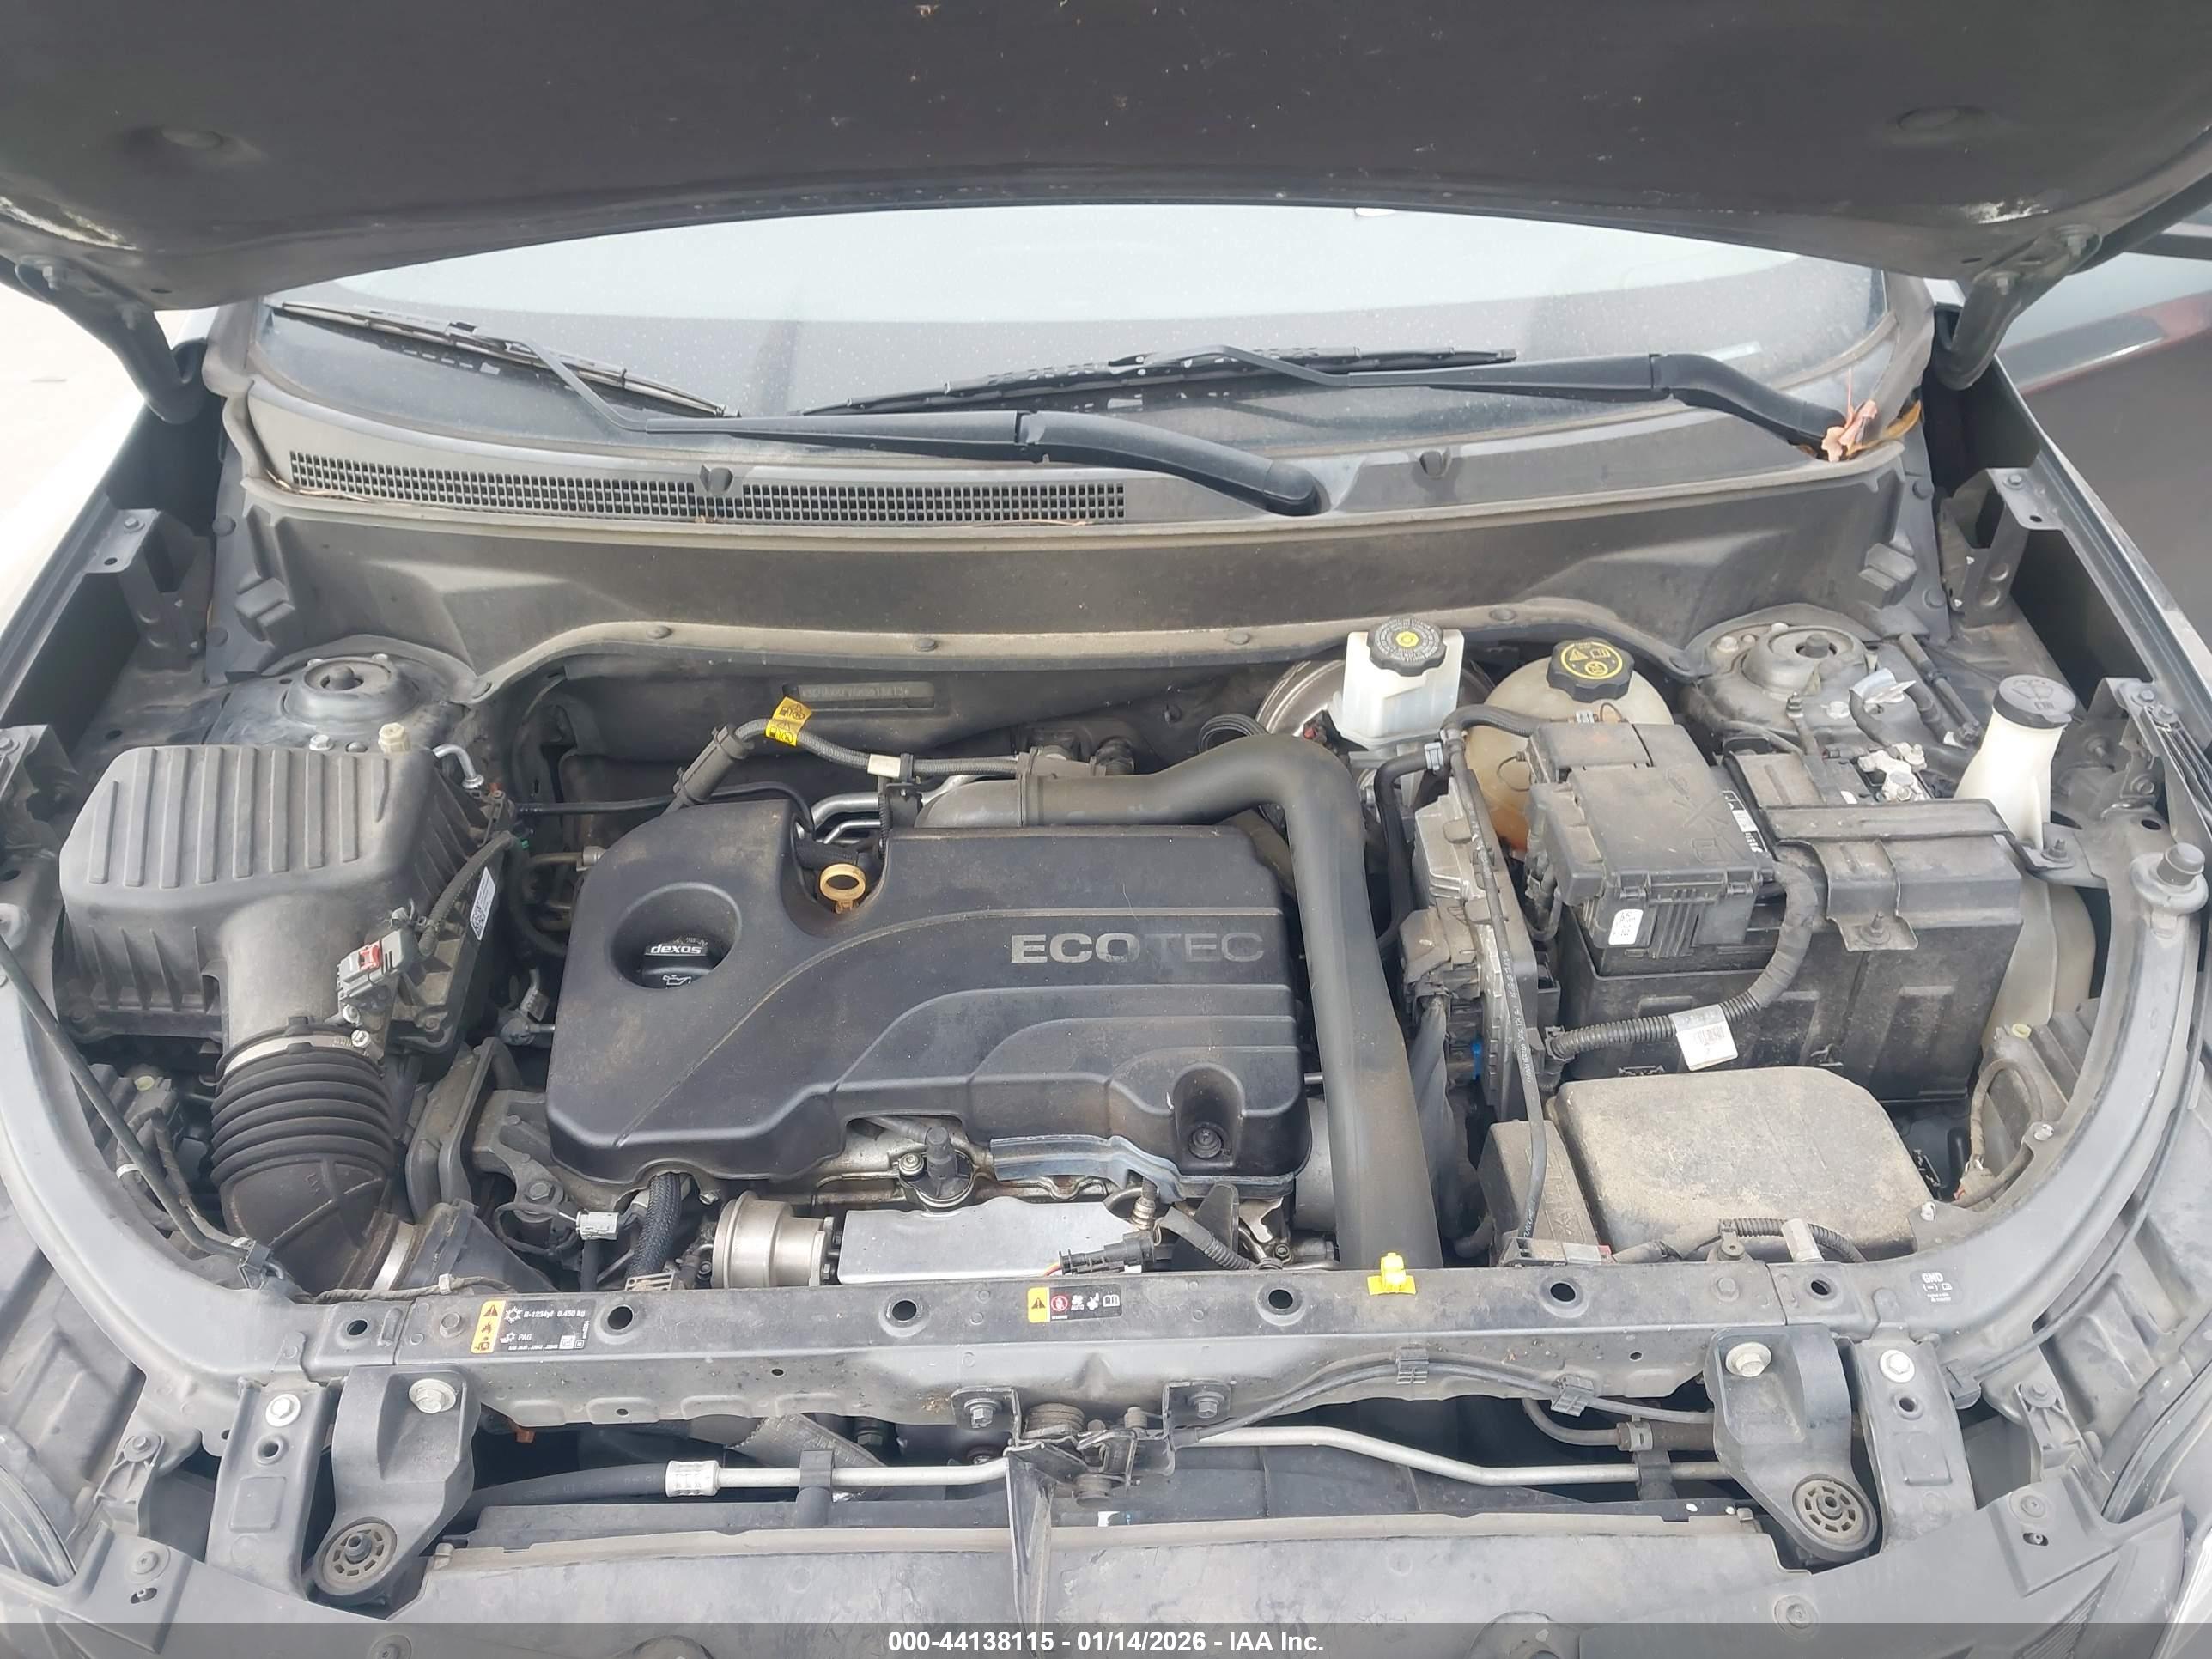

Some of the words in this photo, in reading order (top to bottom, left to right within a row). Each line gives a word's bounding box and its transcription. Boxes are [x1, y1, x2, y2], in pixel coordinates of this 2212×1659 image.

[650, 944, 702, 954] dexos
[1011, 932, 1265, 963] ECOTEC
[1922, 1272, 1943, 1284] GND
